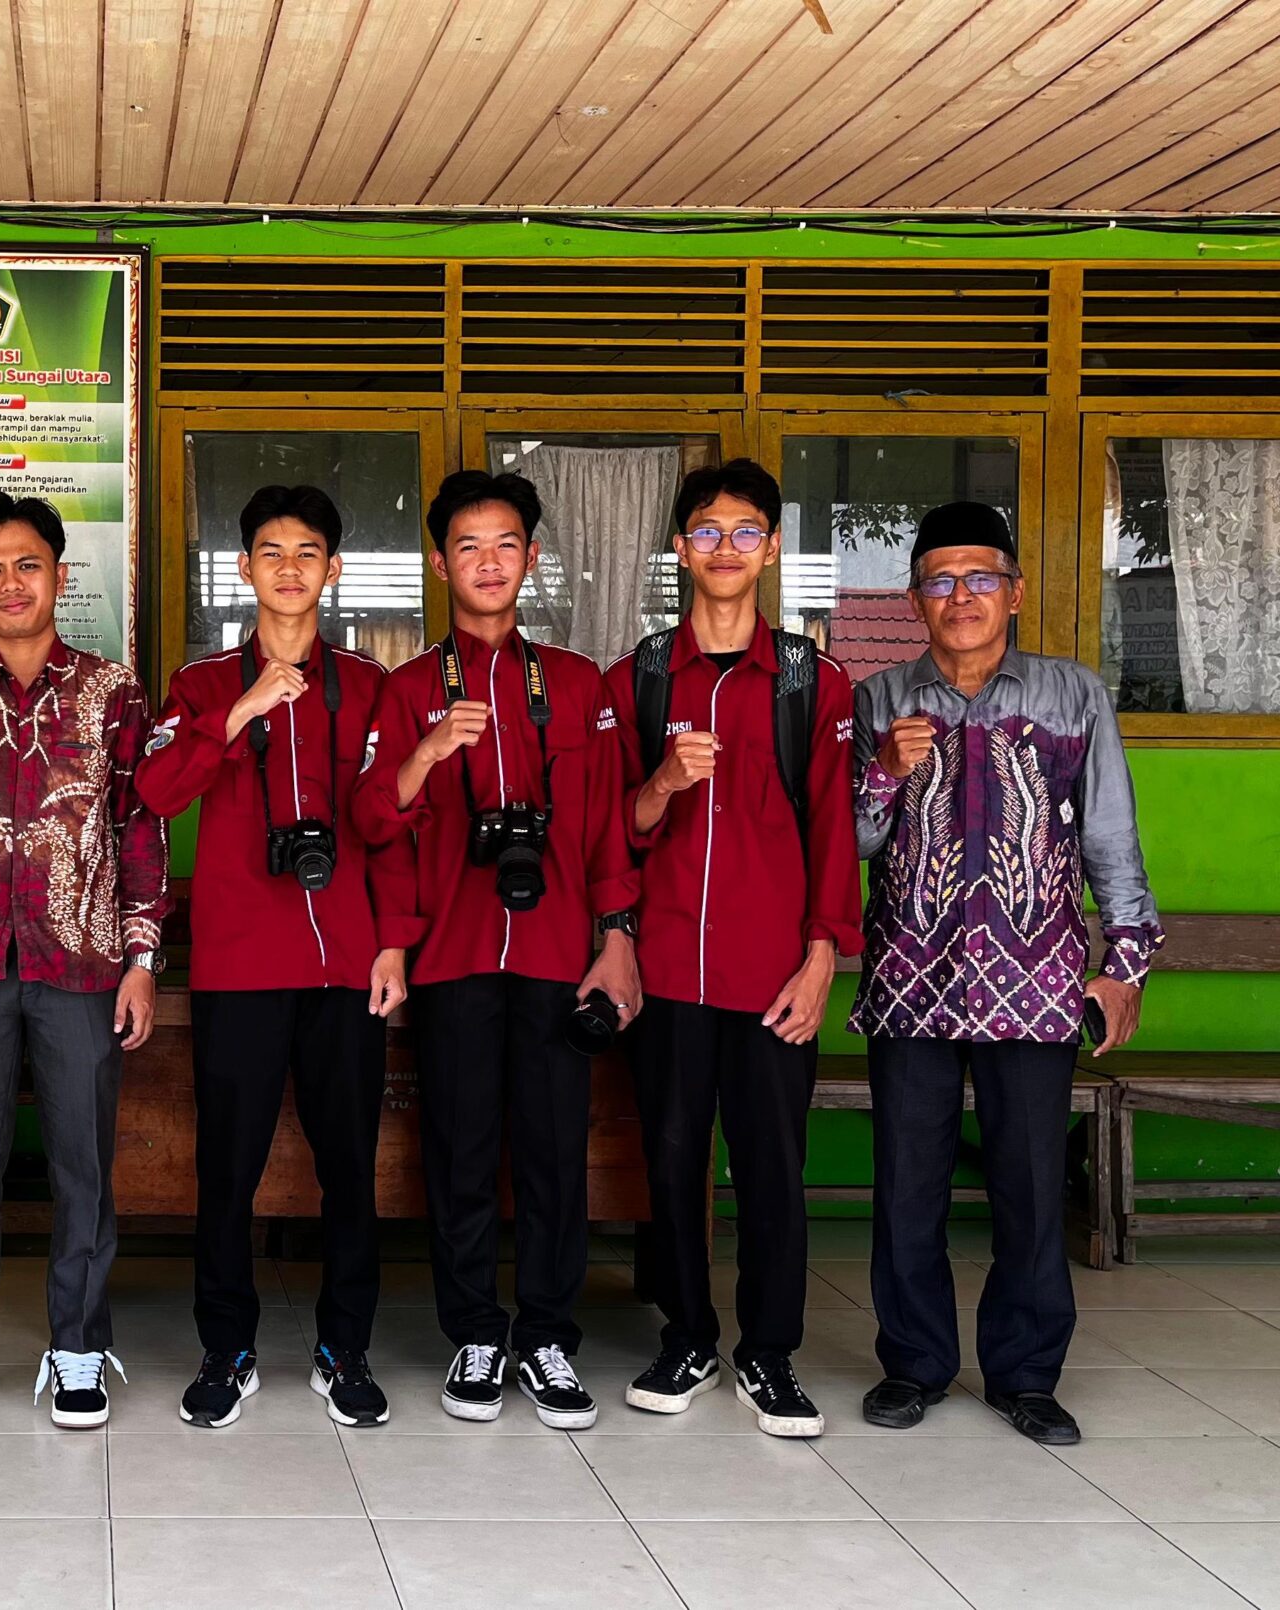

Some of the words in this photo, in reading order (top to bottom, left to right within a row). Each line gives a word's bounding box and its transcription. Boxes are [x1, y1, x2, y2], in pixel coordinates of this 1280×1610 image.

[6, 369, 62, 385] Sungai
[66, 370, 110, 383] Utara
[30, 424, 47, 432] dan
[49, 425, 81, 434] mampu
[40, 434, 48, 442] di
[6, 475, 22, 483] dan
[25, 475, 74, 485] Pengajaran
[39, 485, 87, 494] Pendidikan
[446, 653, 459, 687] Nikon
[529, 661, 543, 696] Nikon
